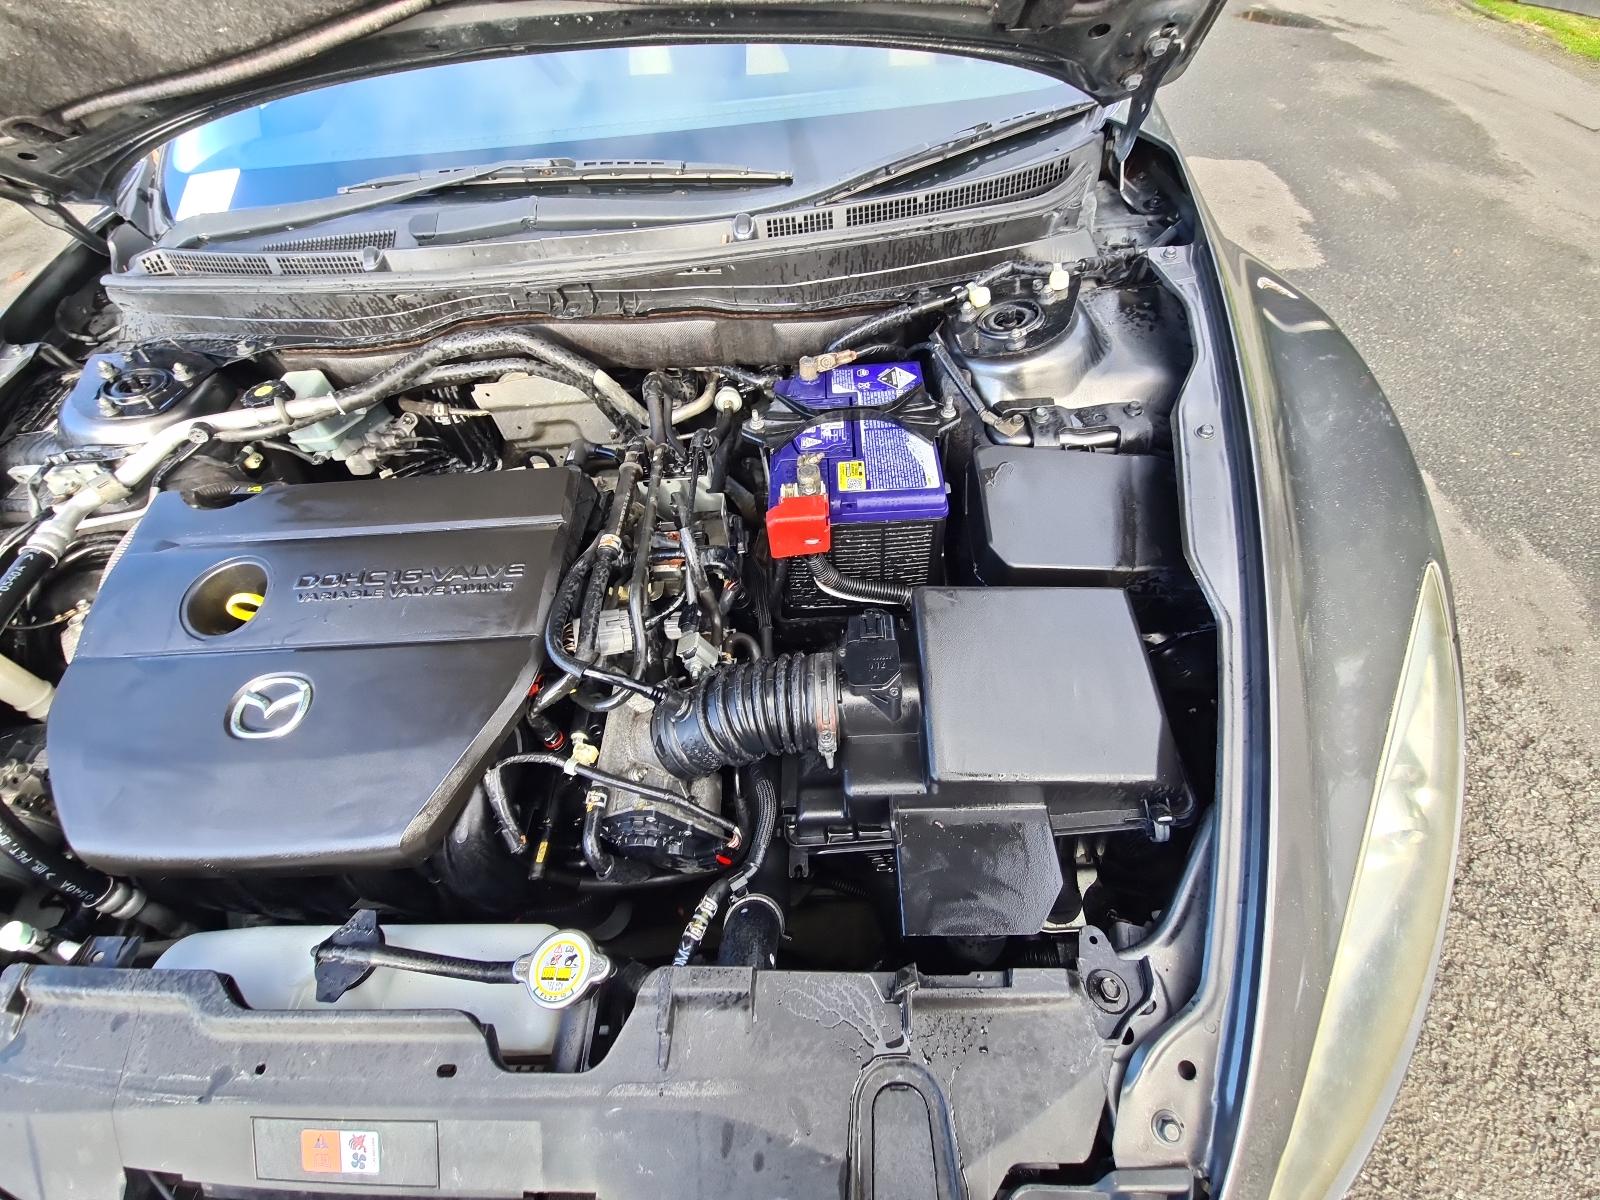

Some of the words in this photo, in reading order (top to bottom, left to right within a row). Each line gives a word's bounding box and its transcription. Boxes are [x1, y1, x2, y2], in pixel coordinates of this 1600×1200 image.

[294, 571, 388, 589] DOHC
[391, 563, 527, 585] 16-VALVE
[296, 588, 386, 603] VARIABLE
[389, 584, 446, 600] VALVE
[449, 581, 515, 595] TIMING
